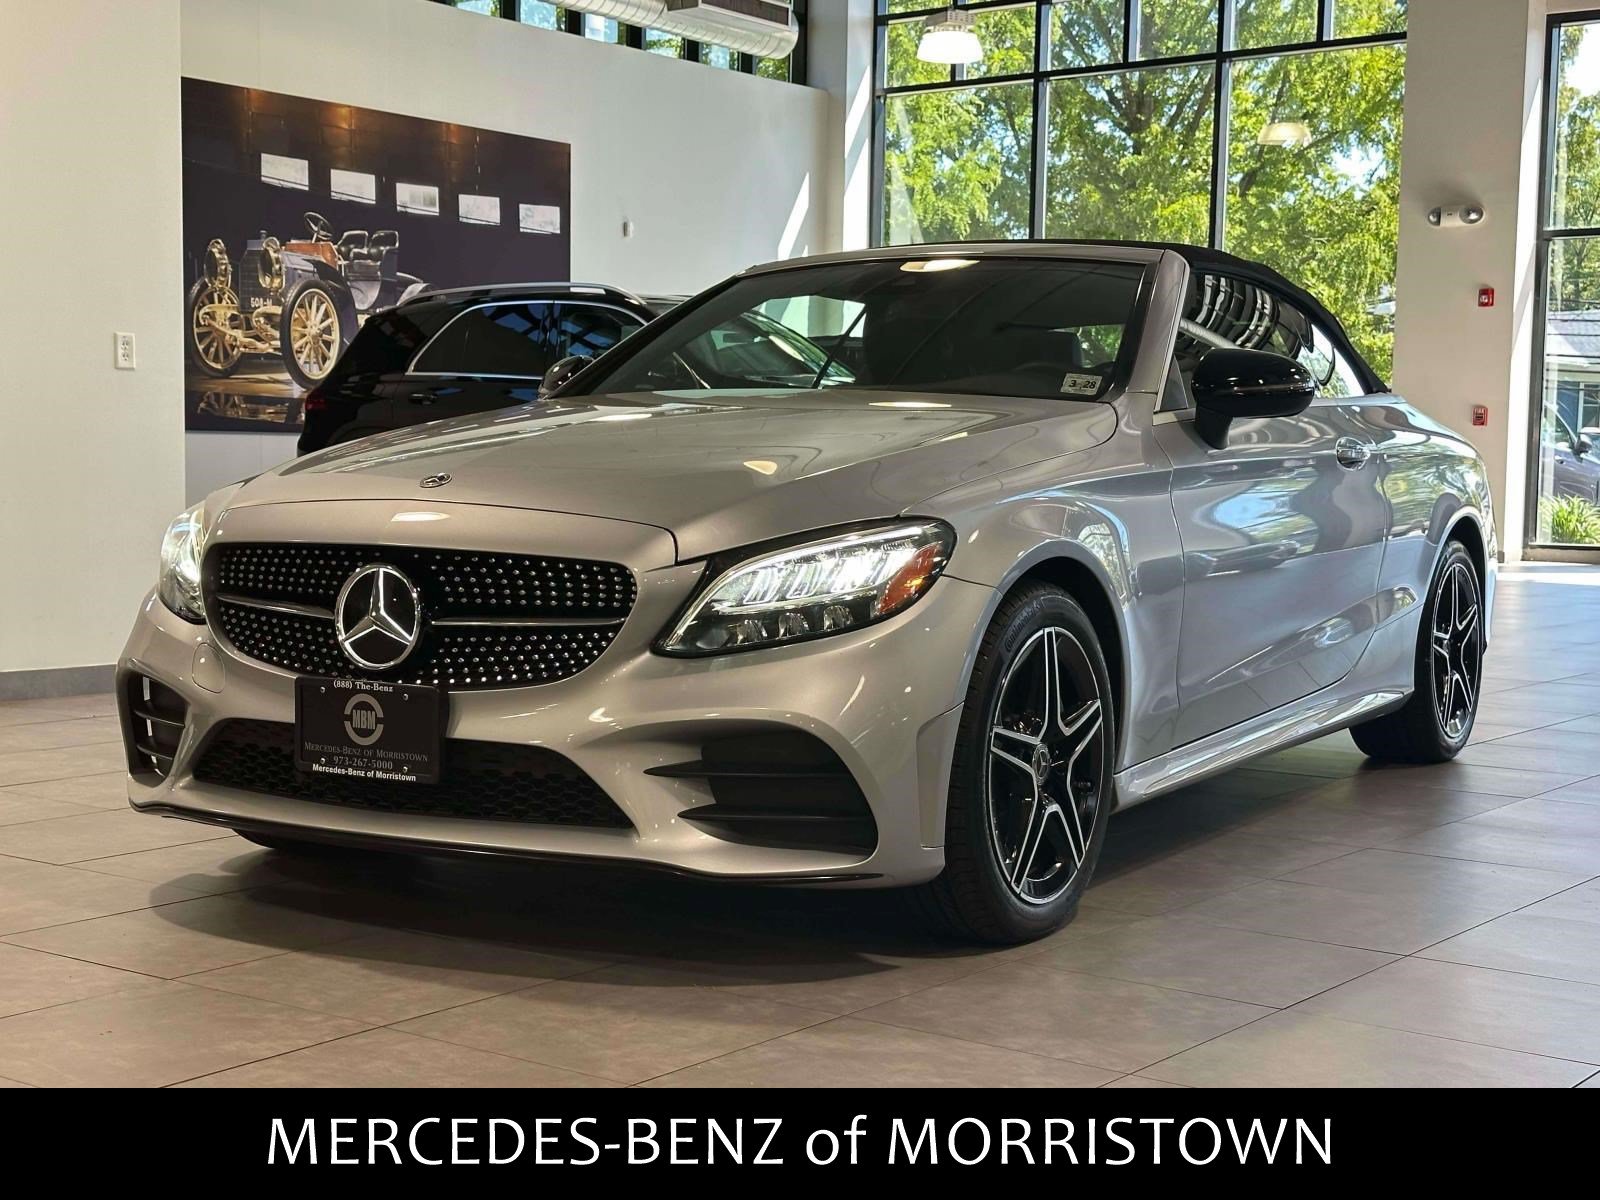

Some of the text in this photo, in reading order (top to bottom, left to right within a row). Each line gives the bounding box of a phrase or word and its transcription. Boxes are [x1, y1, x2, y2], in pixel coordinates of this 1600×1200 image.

[1068, 379, 1097, 389] 3 28
[333, 679, 394, 692] (888) The-Benz
[352, 708, 376, 730] MBM
[333, 756, 393, 769] 973-267-5000
[312, 764, 417, 782] Mercedes-Benz of Morristown
